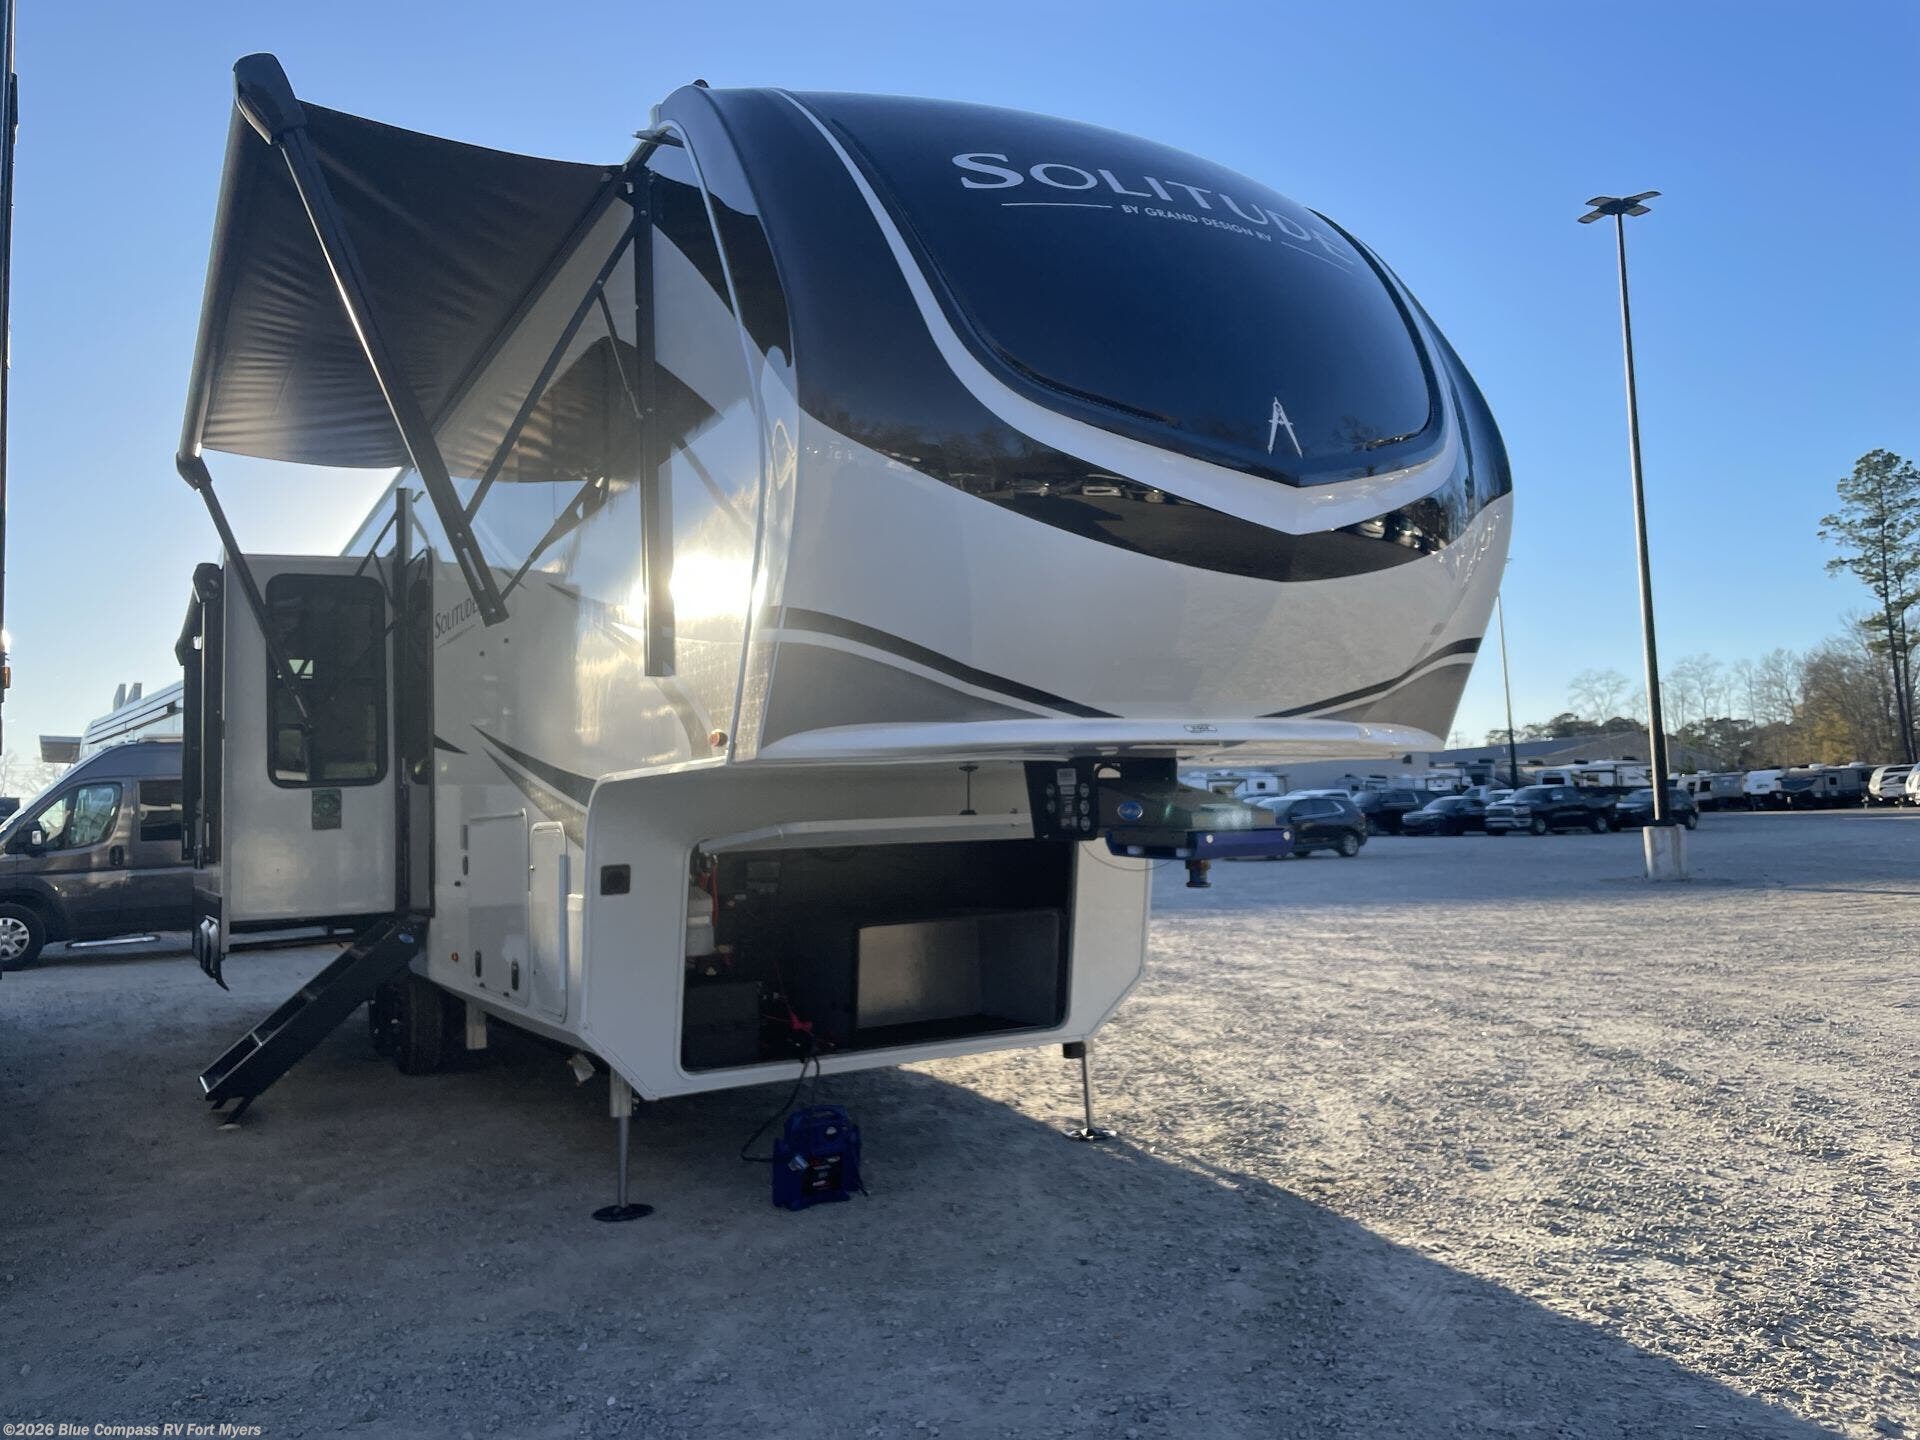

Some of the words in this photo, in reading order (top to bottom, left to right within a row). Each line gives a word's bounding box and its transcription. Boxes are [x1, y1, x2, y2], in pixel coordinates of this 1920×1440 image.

[952, 152, 1354, 264] SOLITUDE
[1121, 204, 1139, 215] BY
[1144, 207, 1198, 223] GRAND
[1201, 216, 1254, 236] DESIGN
